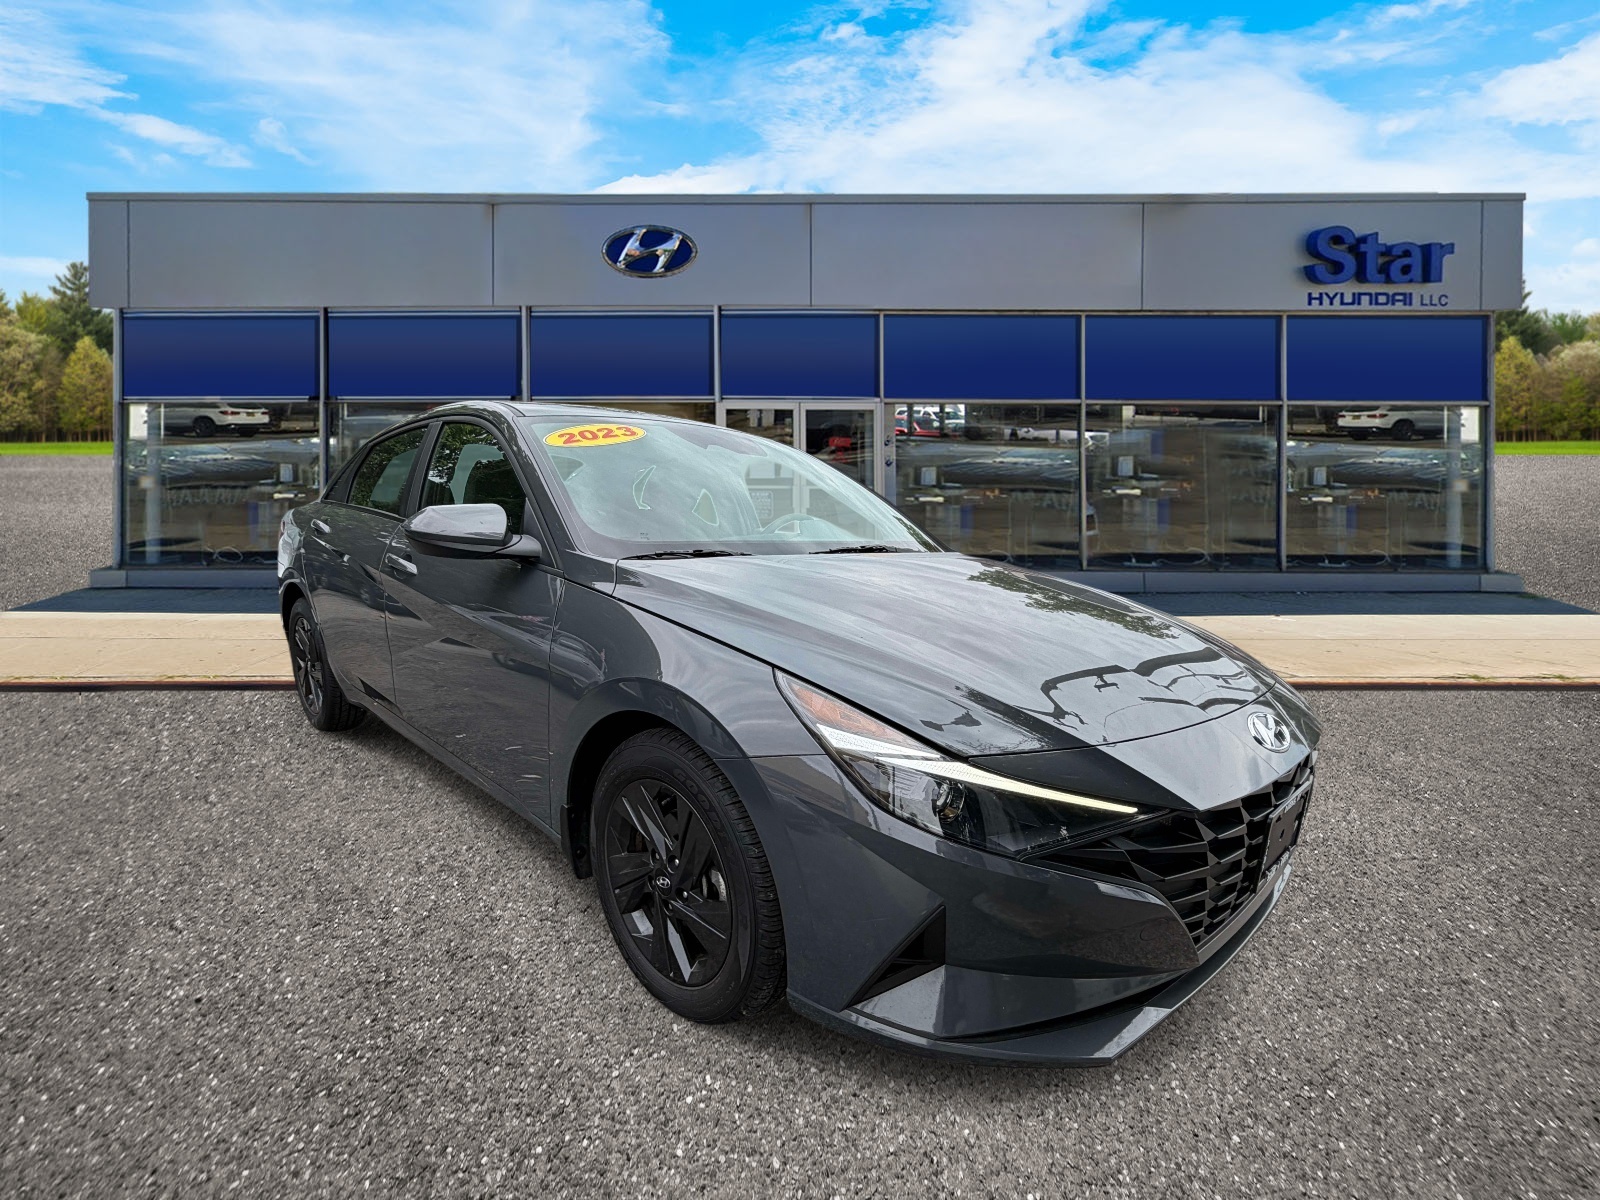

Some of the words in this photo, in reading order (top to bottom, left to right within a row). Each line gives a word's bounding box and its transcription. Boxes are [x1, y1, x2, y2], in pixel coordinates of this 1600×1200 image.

[1303, 225, 1455, 285] Star
[1307, 292, 1413, 306] HYUNDAI
[1420, 294, 1448, 306] LLC
[558, 426, 639, 444] 2023
